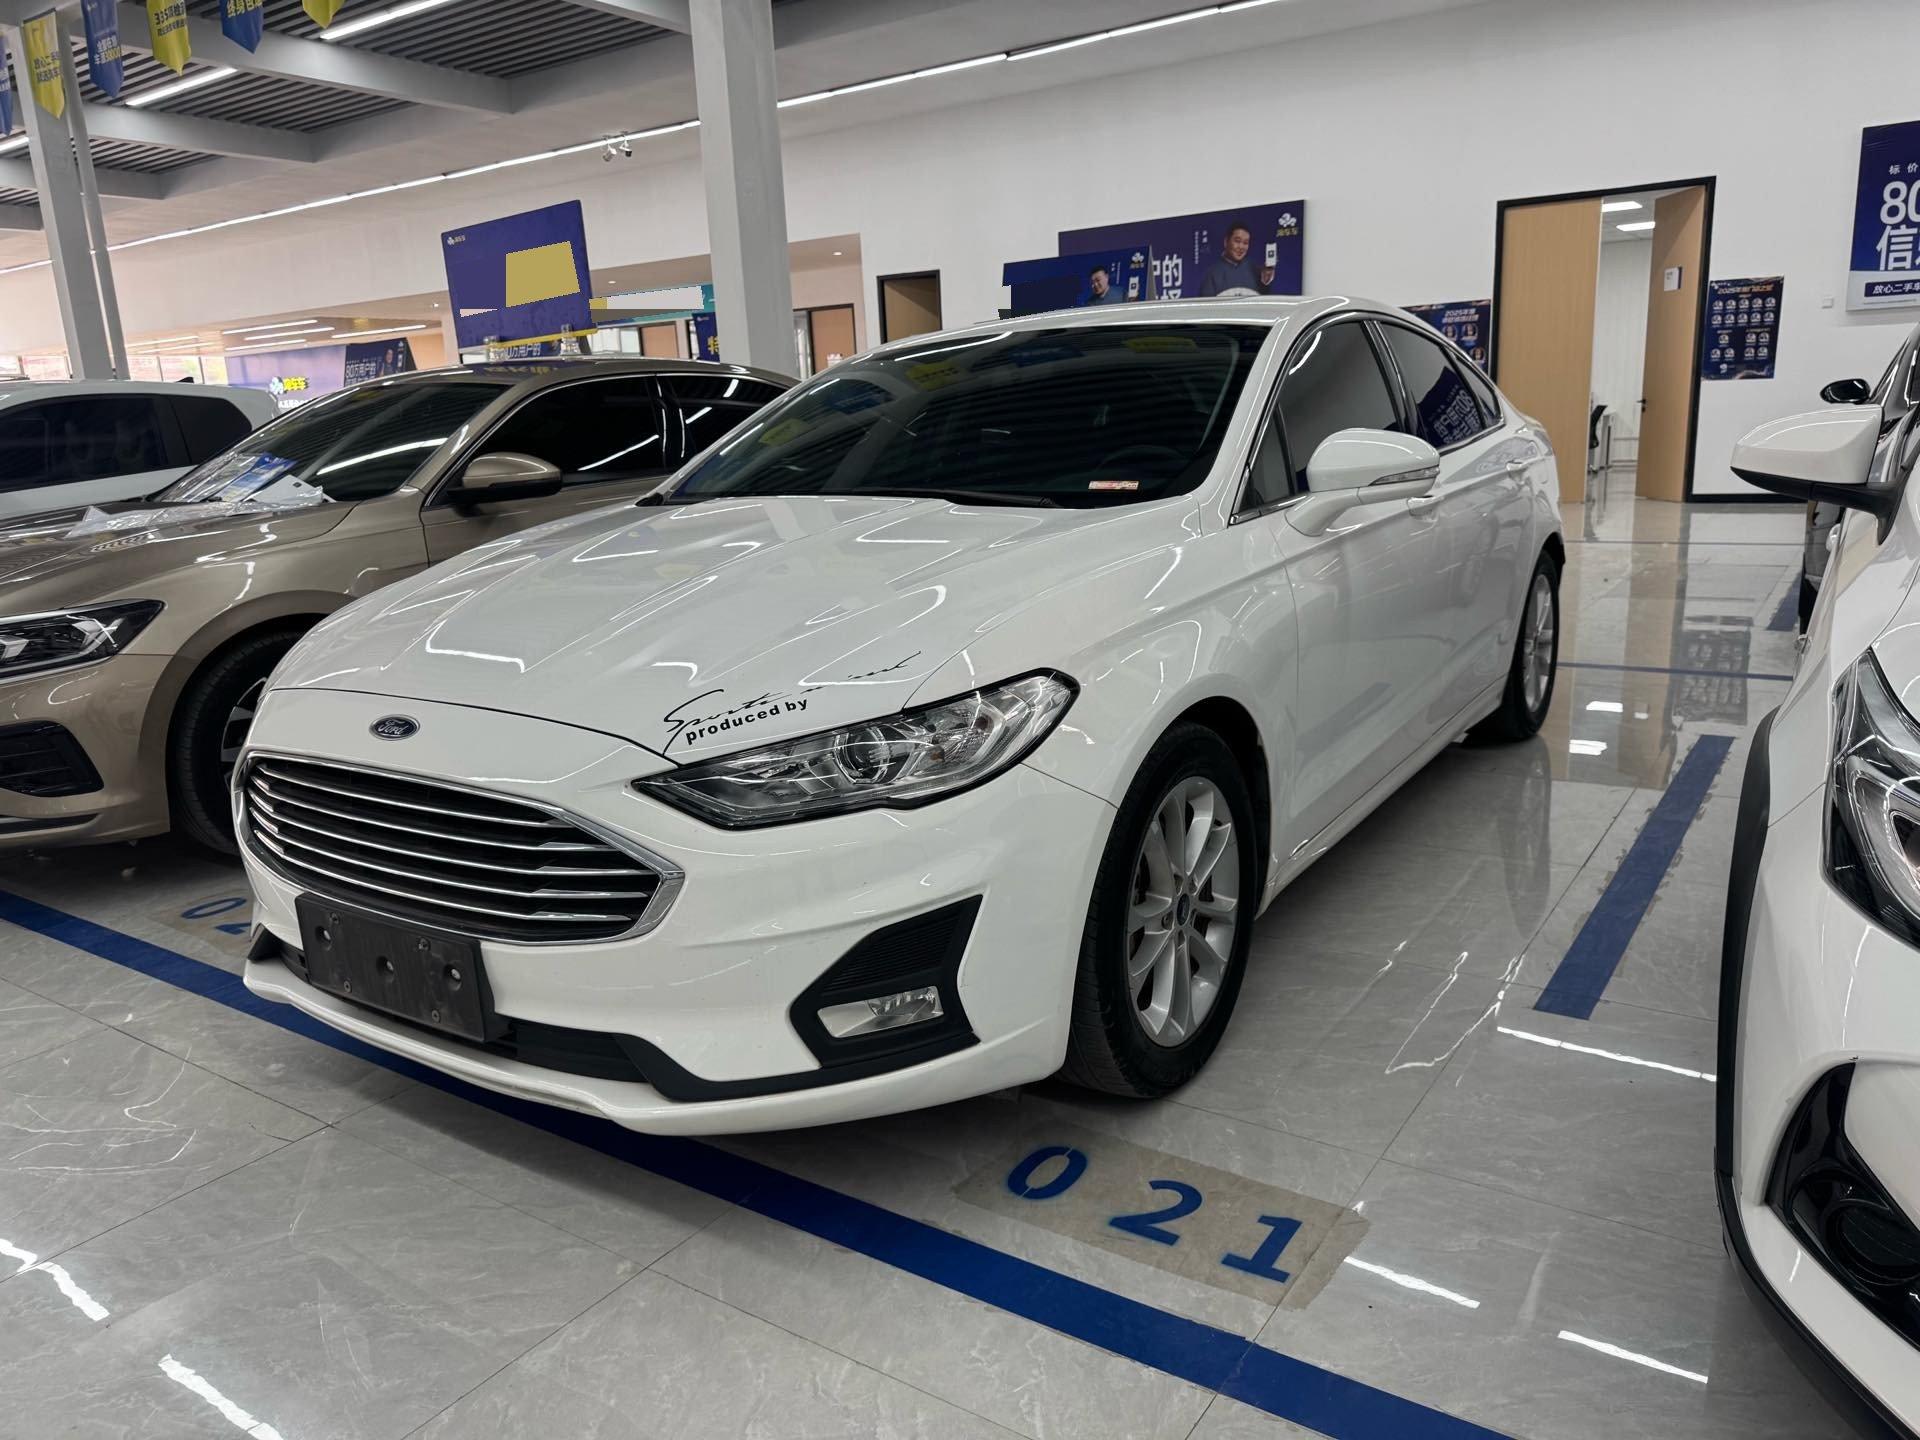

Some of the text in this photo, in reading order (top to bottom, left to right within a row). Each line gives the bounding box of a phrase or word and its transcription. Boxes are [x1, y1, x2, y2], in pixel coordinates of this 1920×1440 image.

[1876, 225, 1920, 271] 信
[377, 719, 409, 735] Ford
[685, 698, 808, 745] produced by
